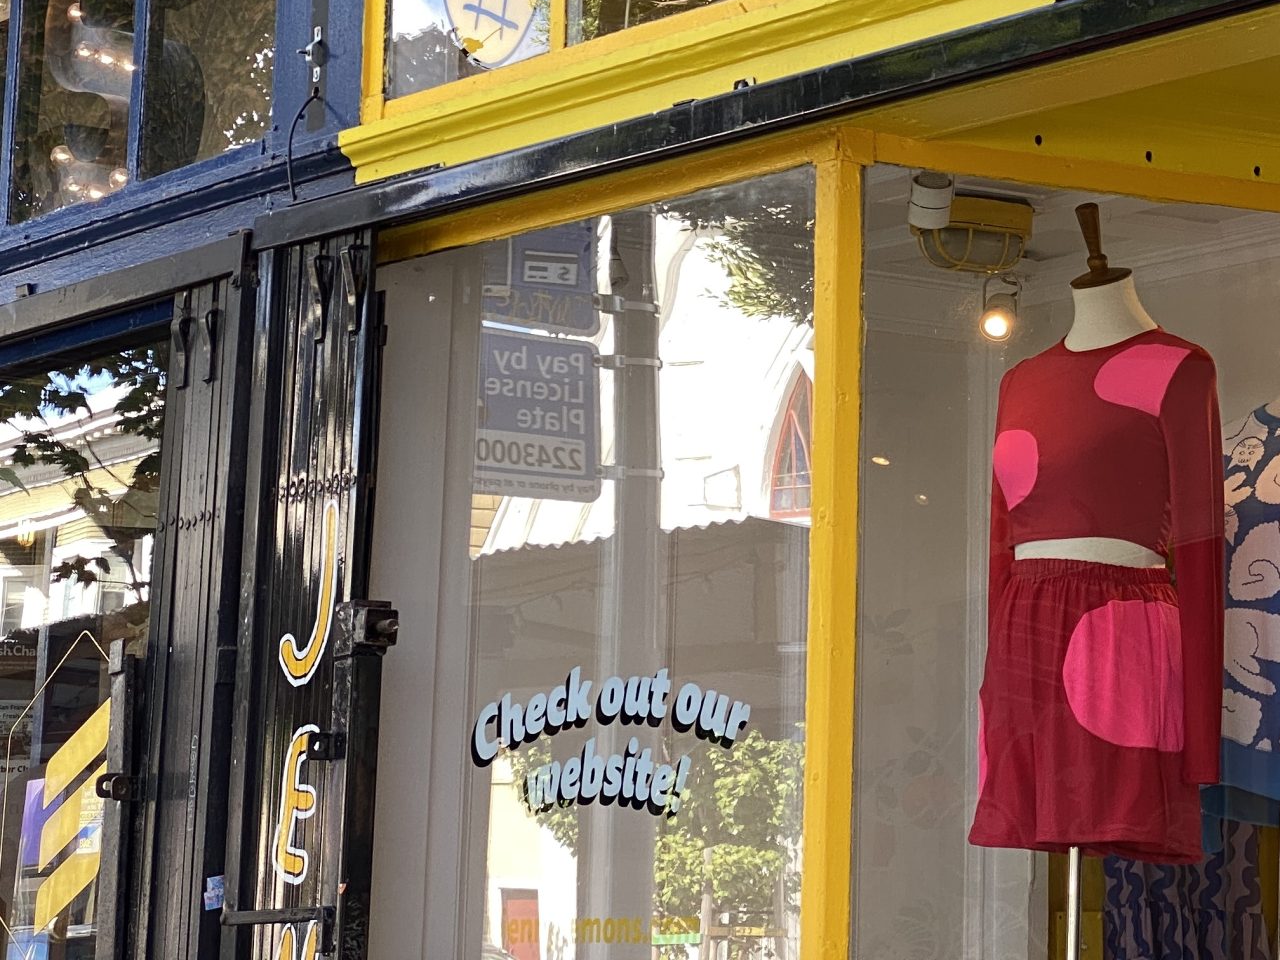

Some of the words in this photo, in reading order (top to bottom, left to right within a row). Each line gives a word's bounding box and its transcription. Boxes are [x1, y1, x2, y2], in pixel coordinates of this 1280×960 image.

[472, 666, 593, 767] Check
[596, 667, 671, 728] out
[672, 682, 751, 749] our
[523, 736, 692, 819] website!
